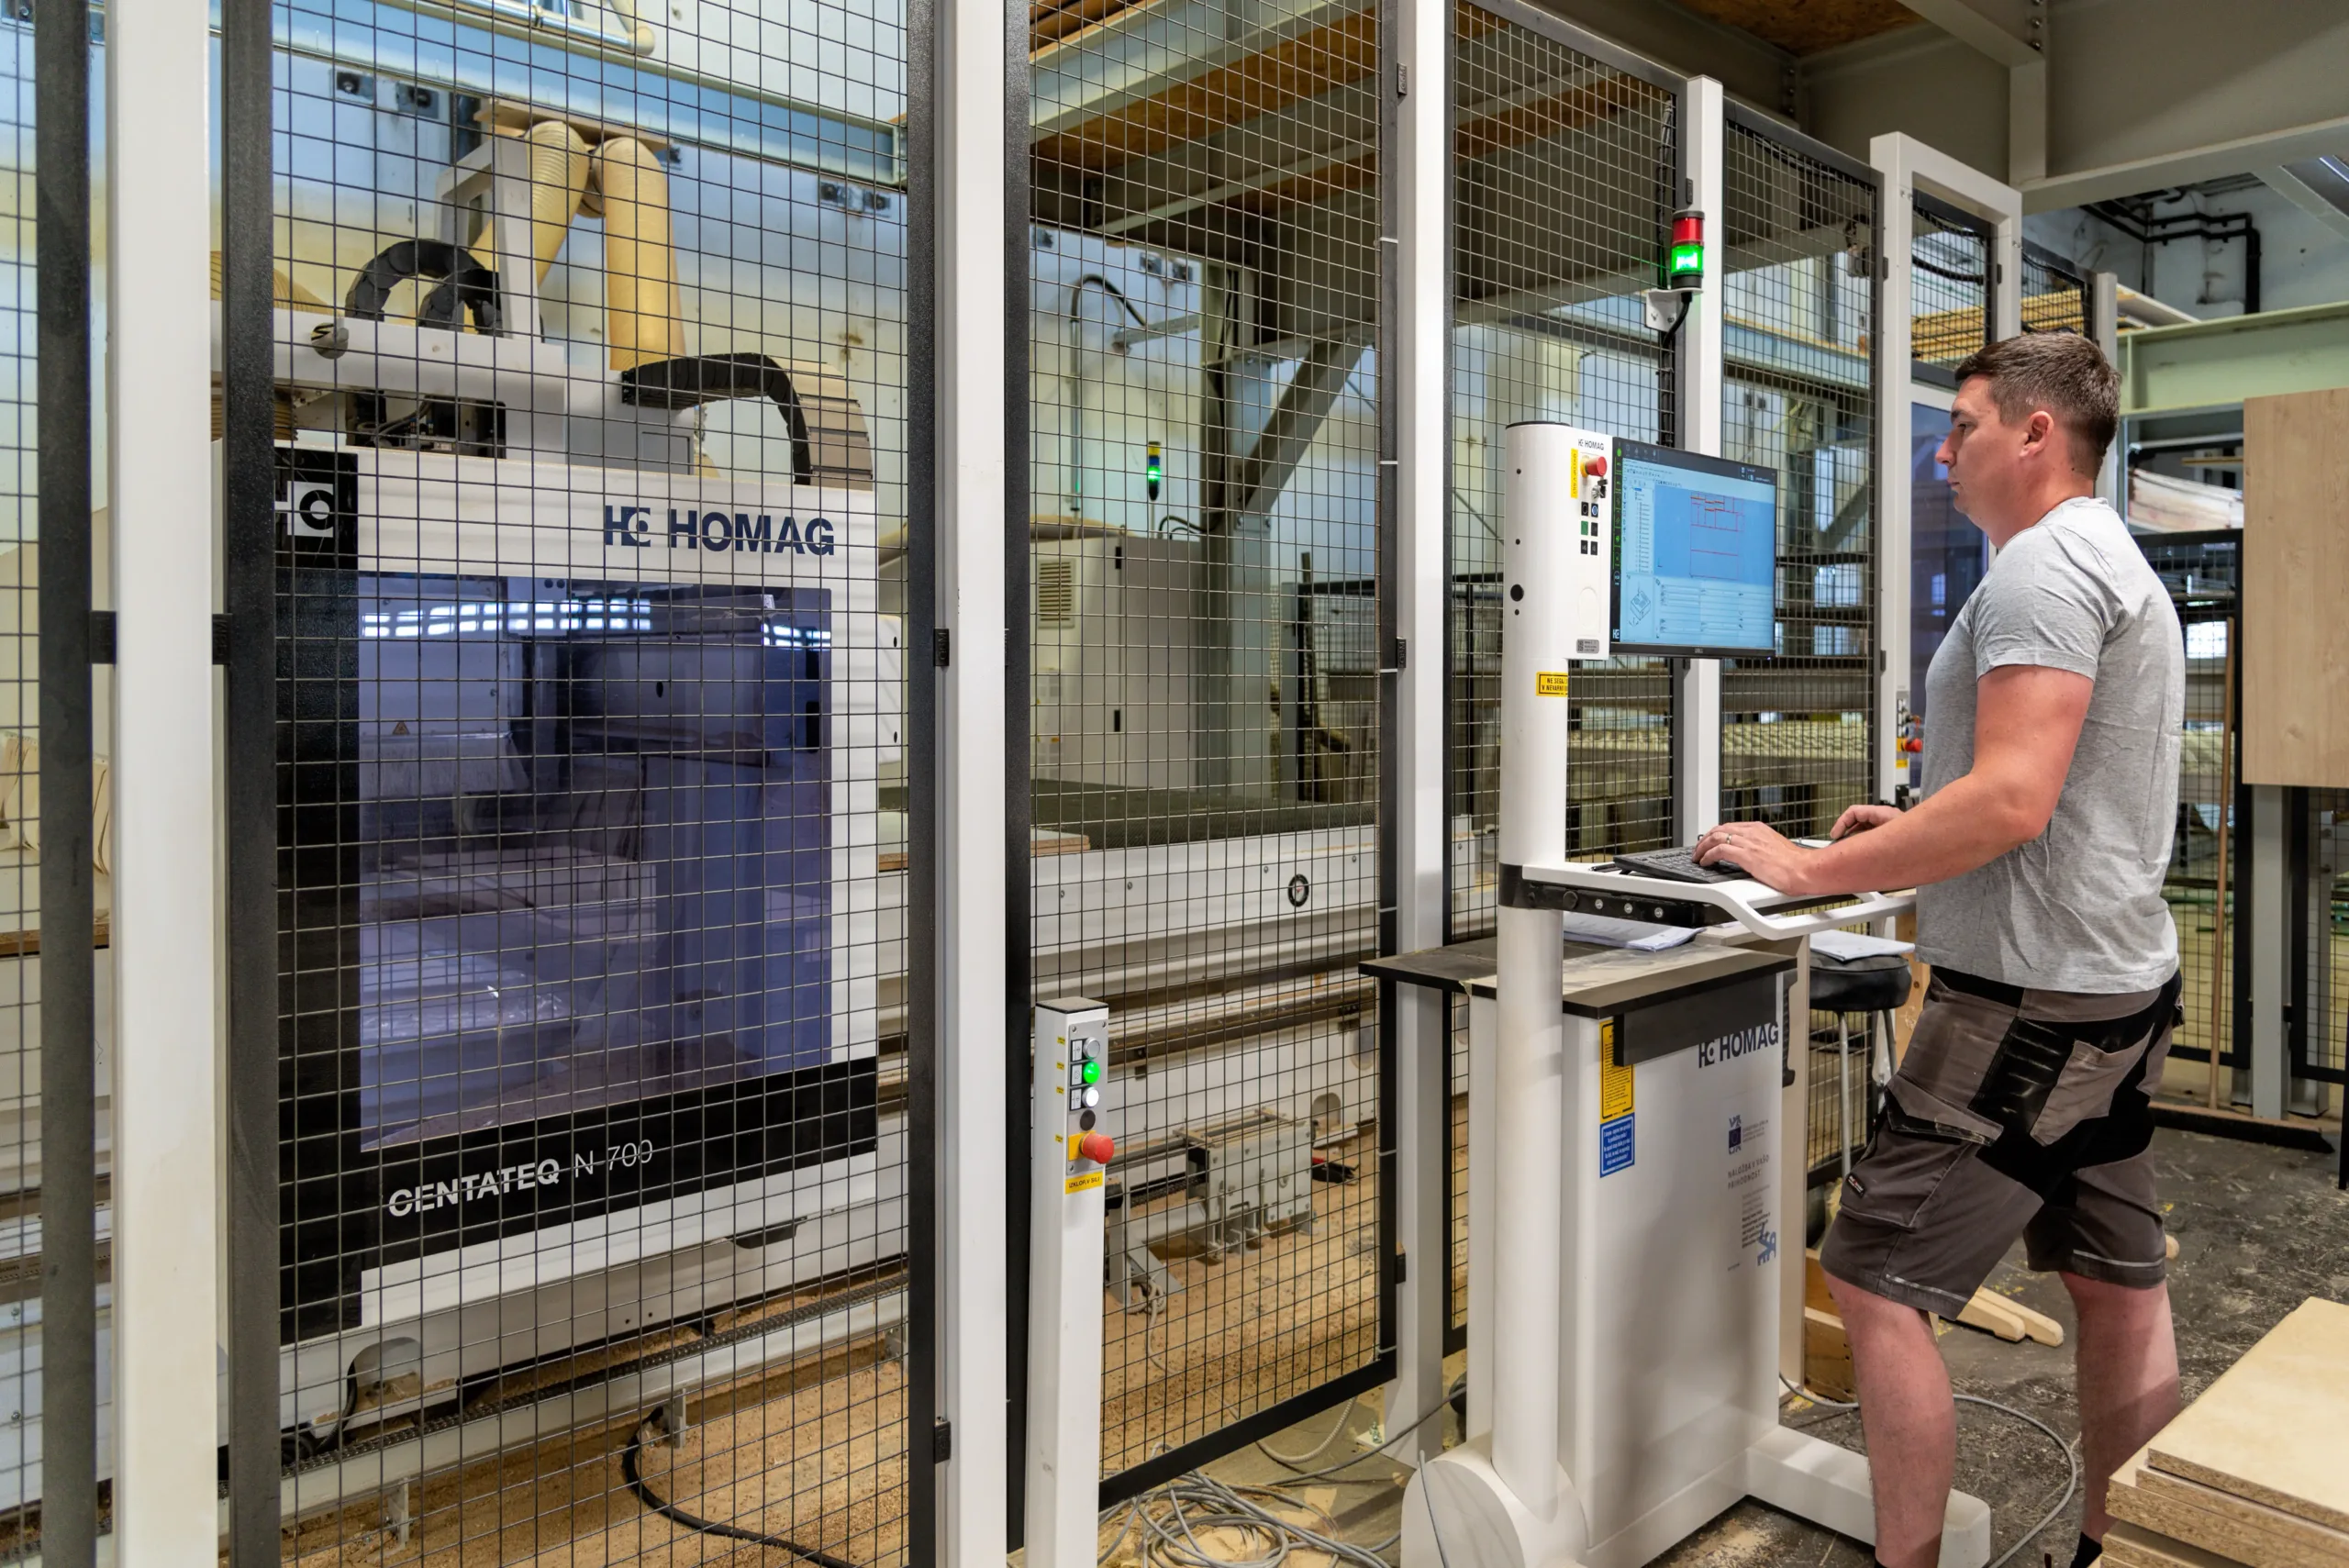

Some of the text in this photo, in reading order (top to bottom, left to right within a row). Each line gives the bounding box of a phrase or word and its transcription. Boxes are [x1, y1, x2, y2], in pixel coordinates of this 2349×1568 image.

[1585, 440, 1605, 450] HOMAG
[668, 508, 835, 556] HOMAG
[1720, 1021, 1779, 1062] HOMAG
[388, 1139, 653, 1218] CENTATEQ N 700
